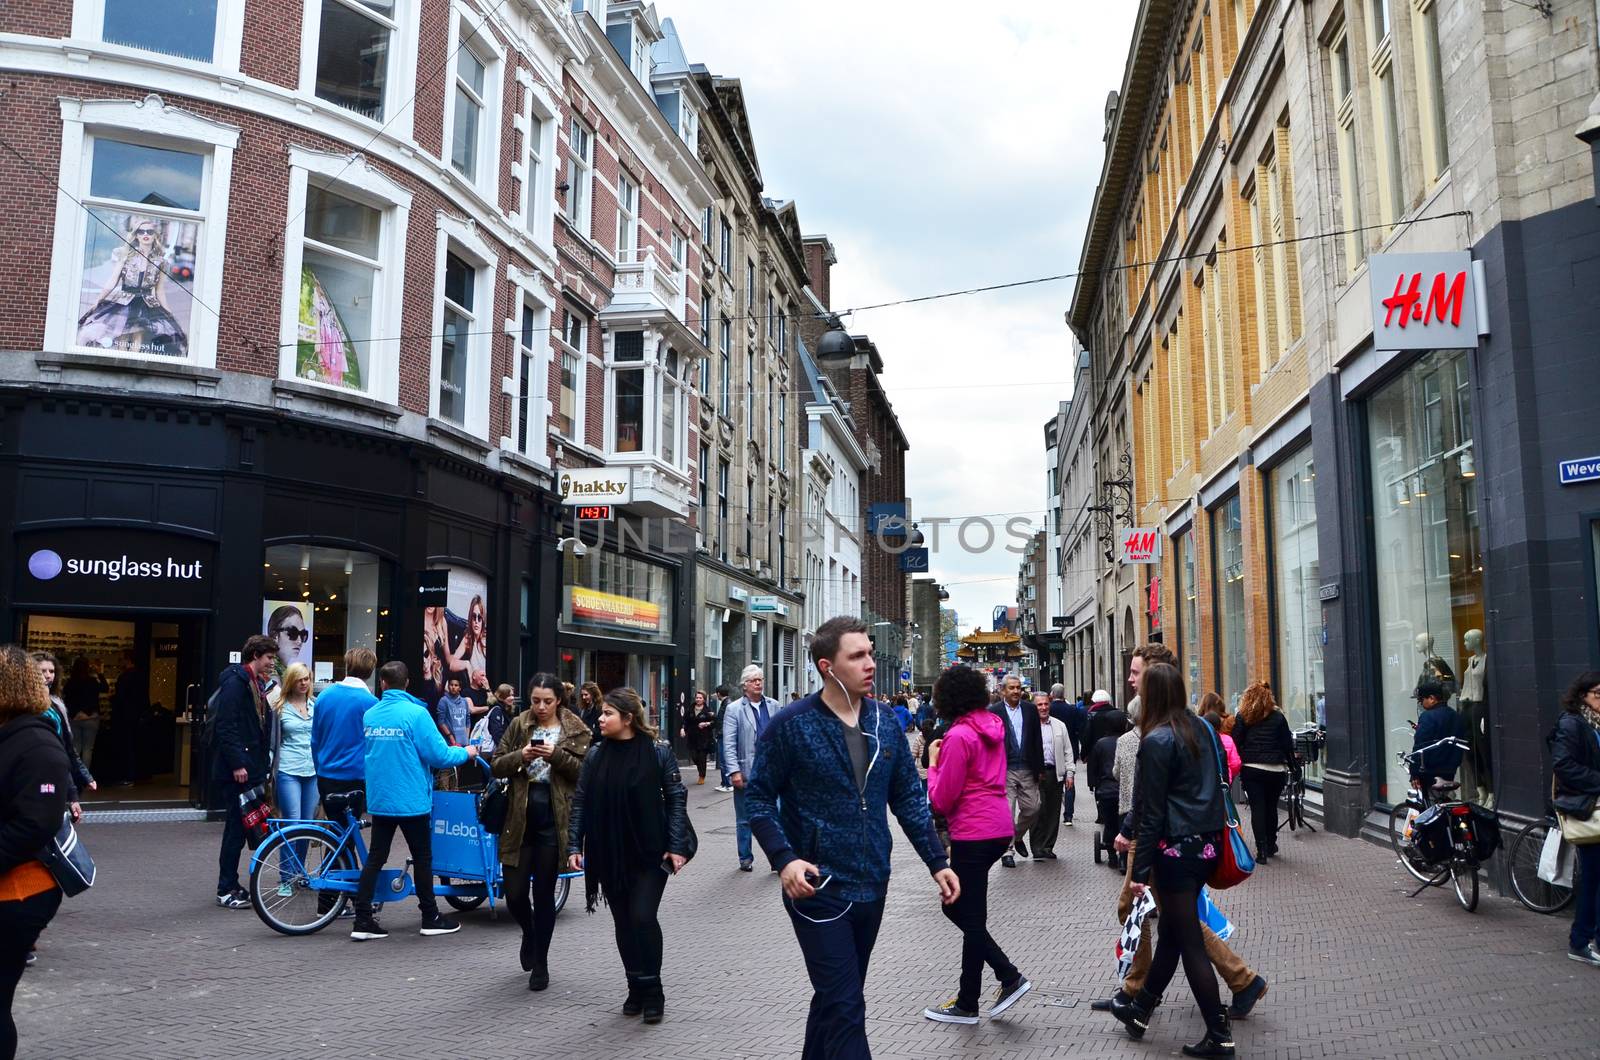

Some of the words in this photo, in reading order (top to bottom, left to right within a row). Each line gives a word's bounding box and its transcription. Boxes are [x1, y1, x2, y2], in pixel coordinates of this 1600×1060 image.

[1382, 271, 1467, 329] H&M
[572, 480, 627, 495] hakky
[1124, 531, 1156, 554] H&M
[66, 555, 162, 581] sunglass
[167, 557, 202, 579] hut
